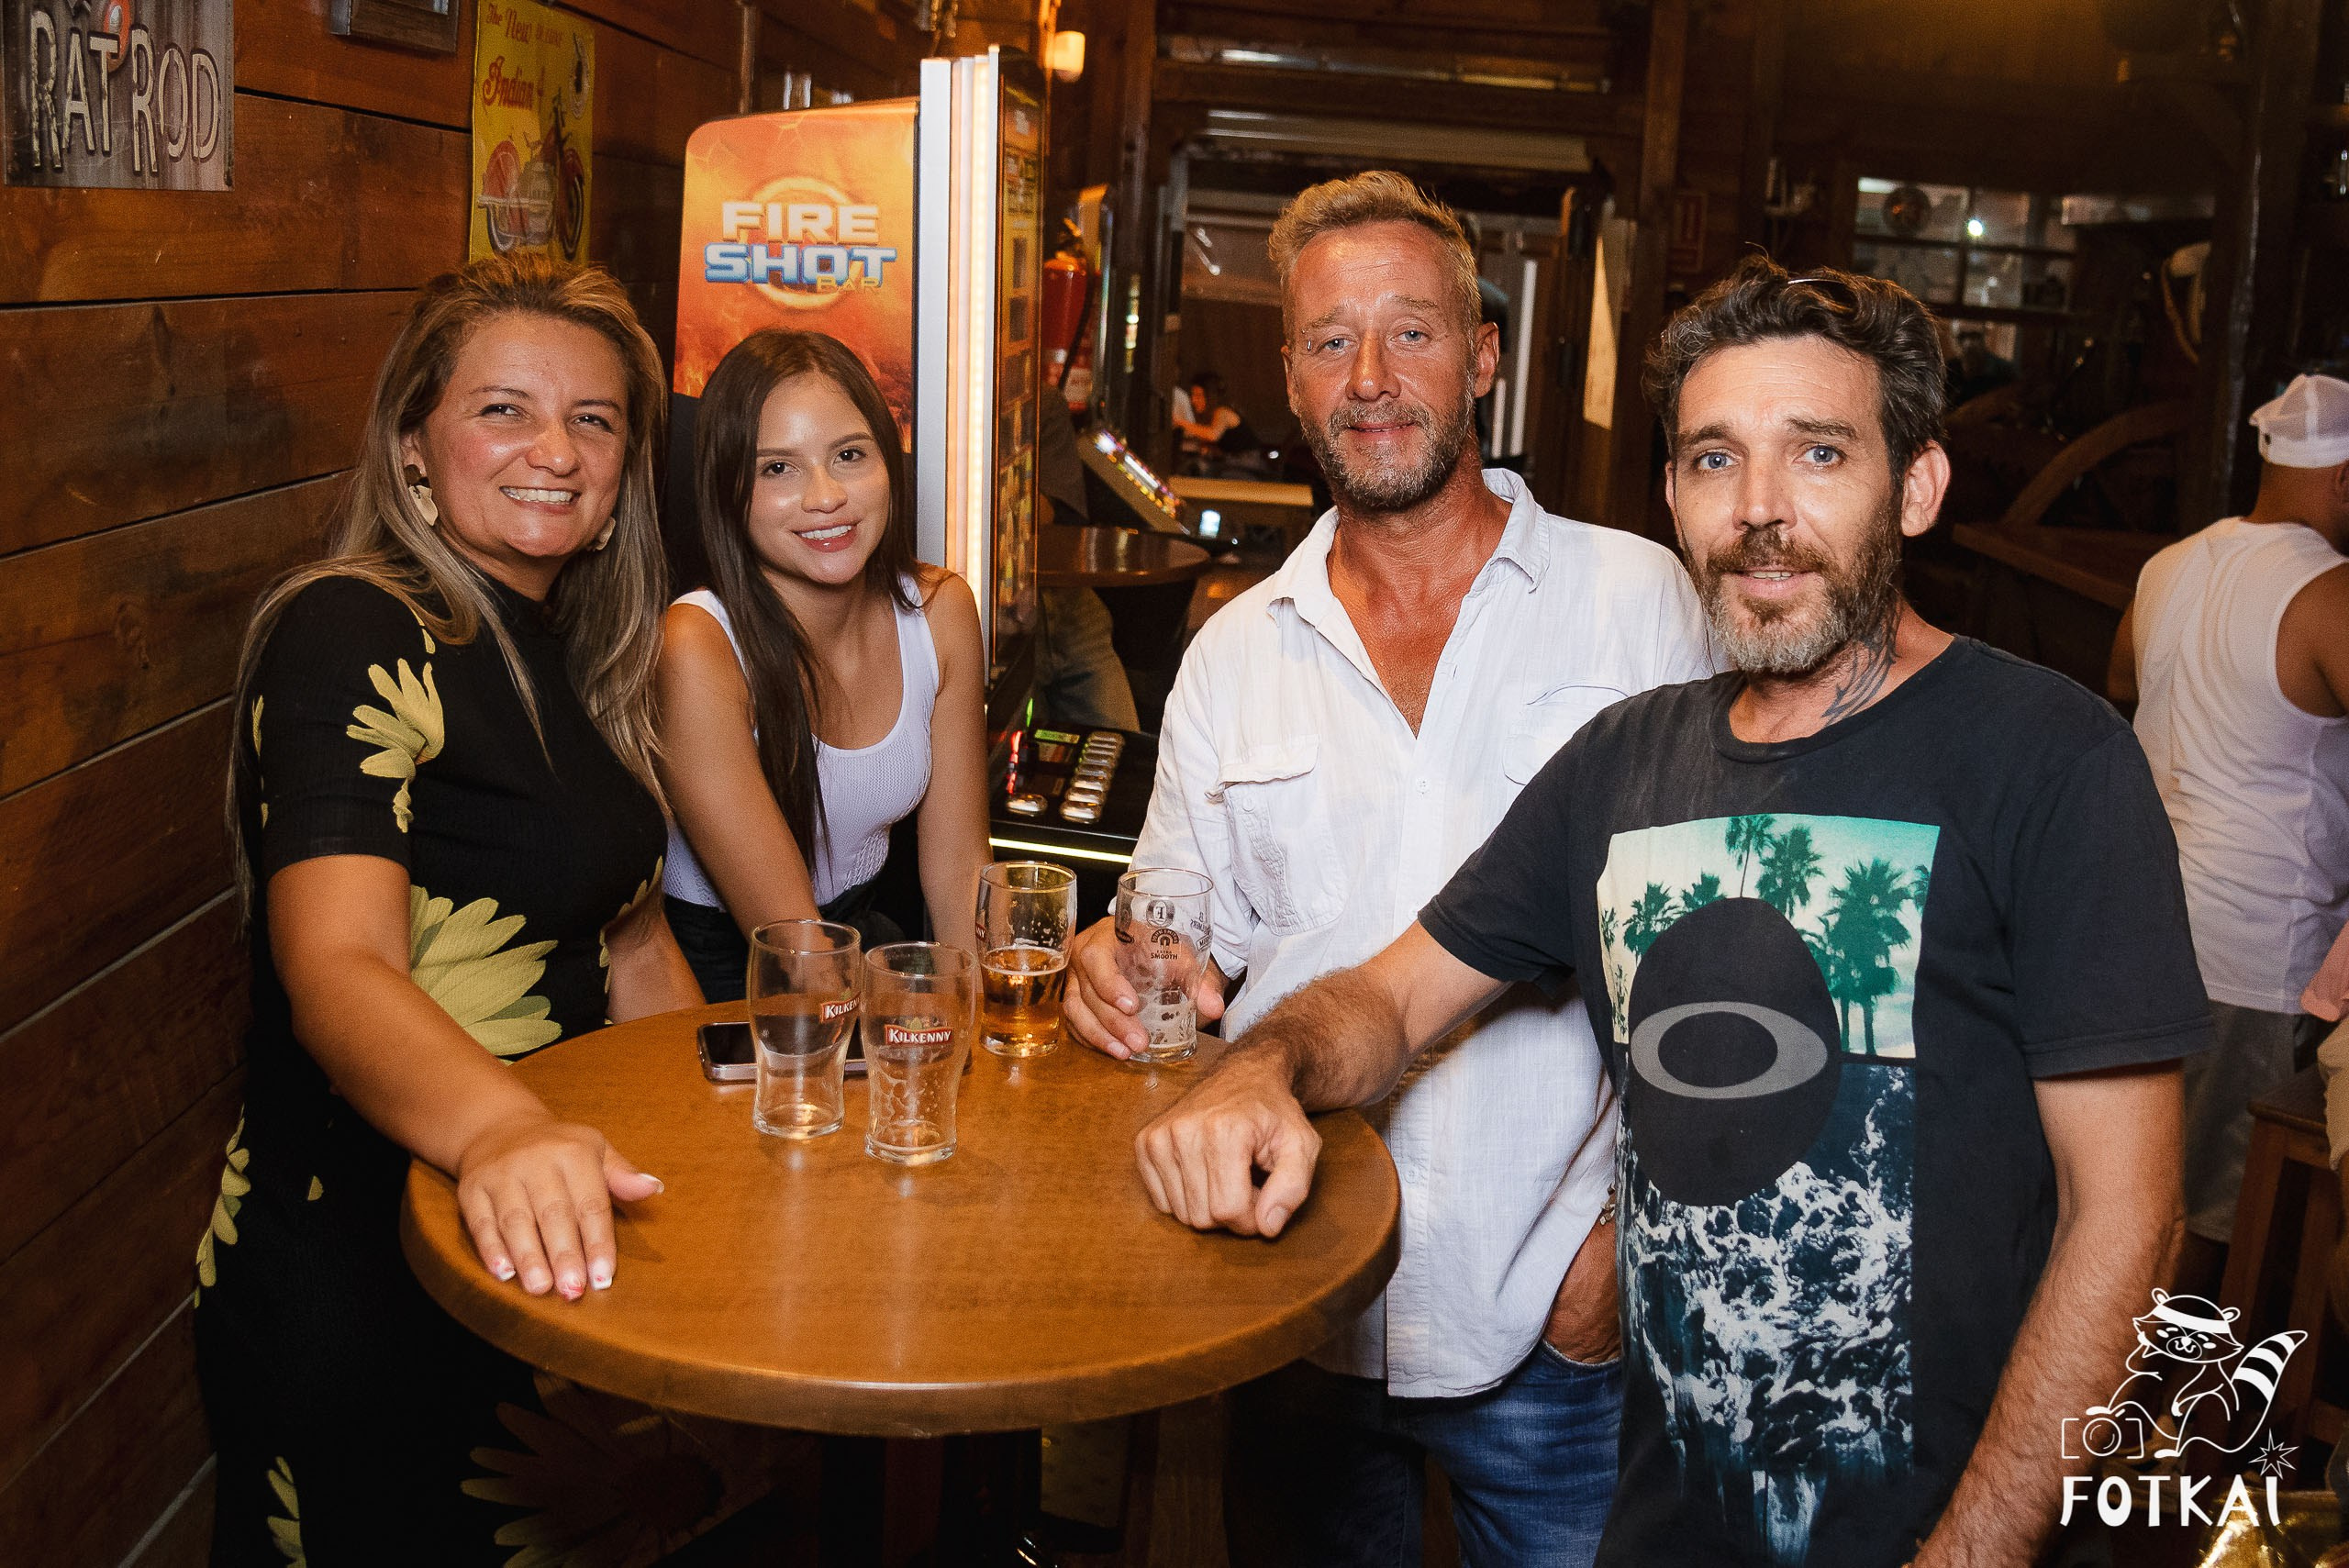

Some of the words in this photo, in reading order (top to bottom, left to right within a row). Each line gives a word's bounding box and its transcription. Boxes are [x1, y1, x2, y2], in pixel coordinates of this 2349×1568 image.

[30, 10, 120, 168] RAT
[131, 28, 220, 172] ROD
[483, 55, 534, 109] Indian
[722, 201, 880, 246] FIRE
[705, 242, 897, 287] SHOT
[817, 275, 881, 293] BAR
[889, 1029, 952, 1044] KILKENNY
